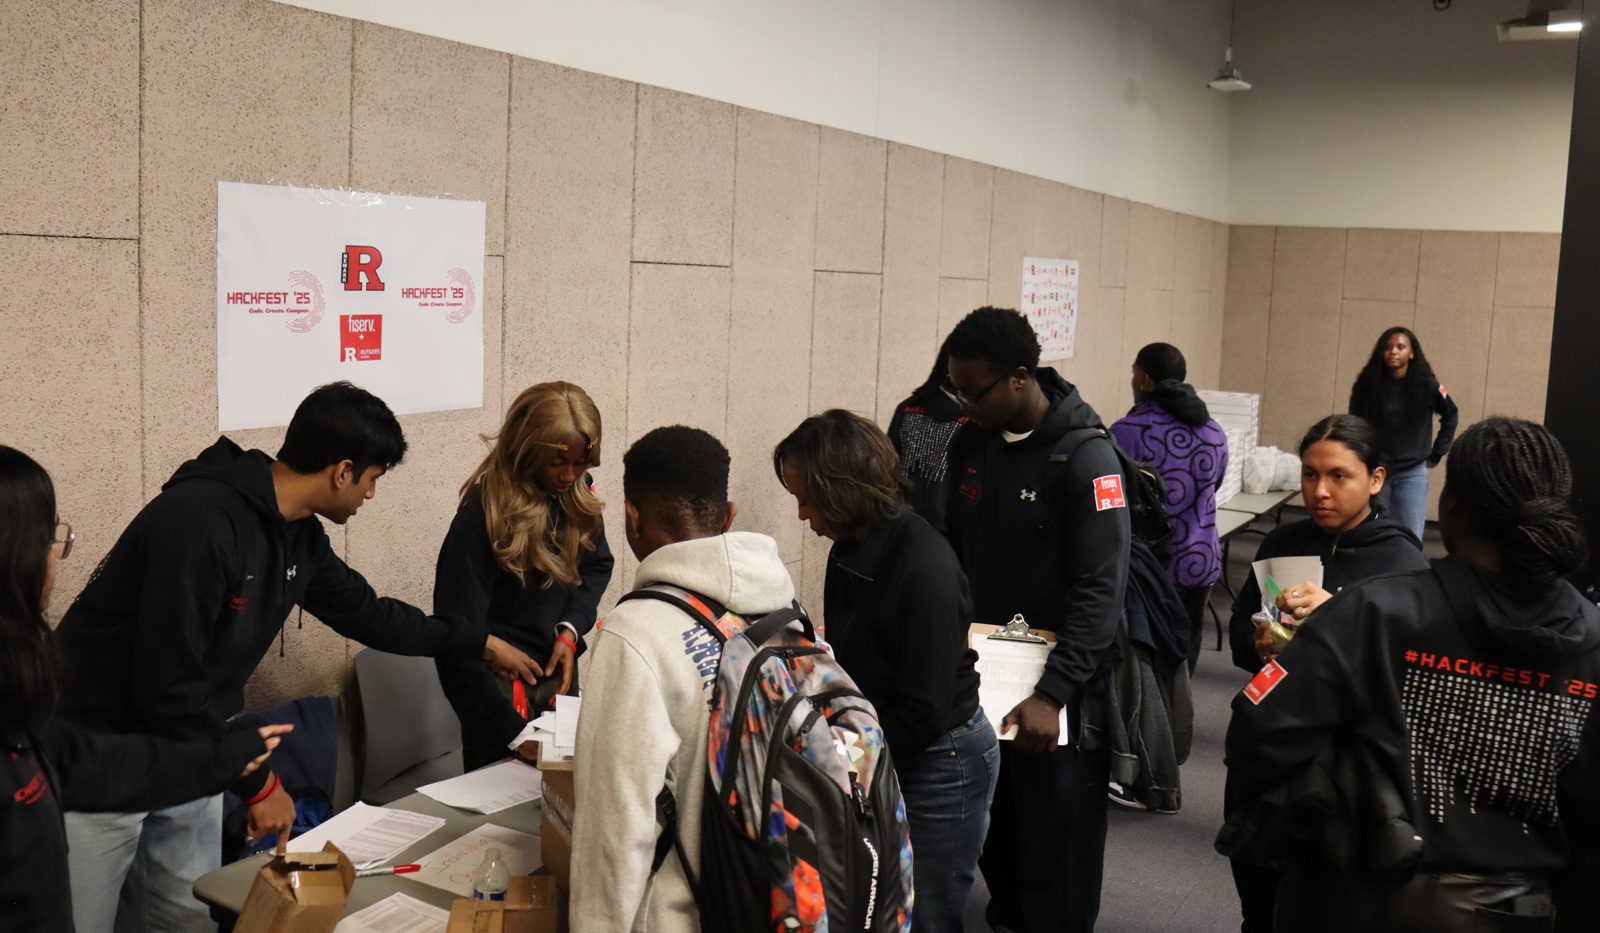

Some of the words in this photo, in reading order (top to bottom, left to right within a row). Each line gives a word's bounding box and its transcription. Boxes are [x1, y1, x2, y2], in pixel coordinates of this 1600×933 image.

[344, 245, 385, 291] R
[226, 291, 288, 305] HACKFEST
[401, 287, 447, 299] HACKFEST
[348, 315, 376, 333] fiserv.
[1404, 649, 1551, 688] #HACKFEST
[864, 878, 877, 929] ARMOUR
